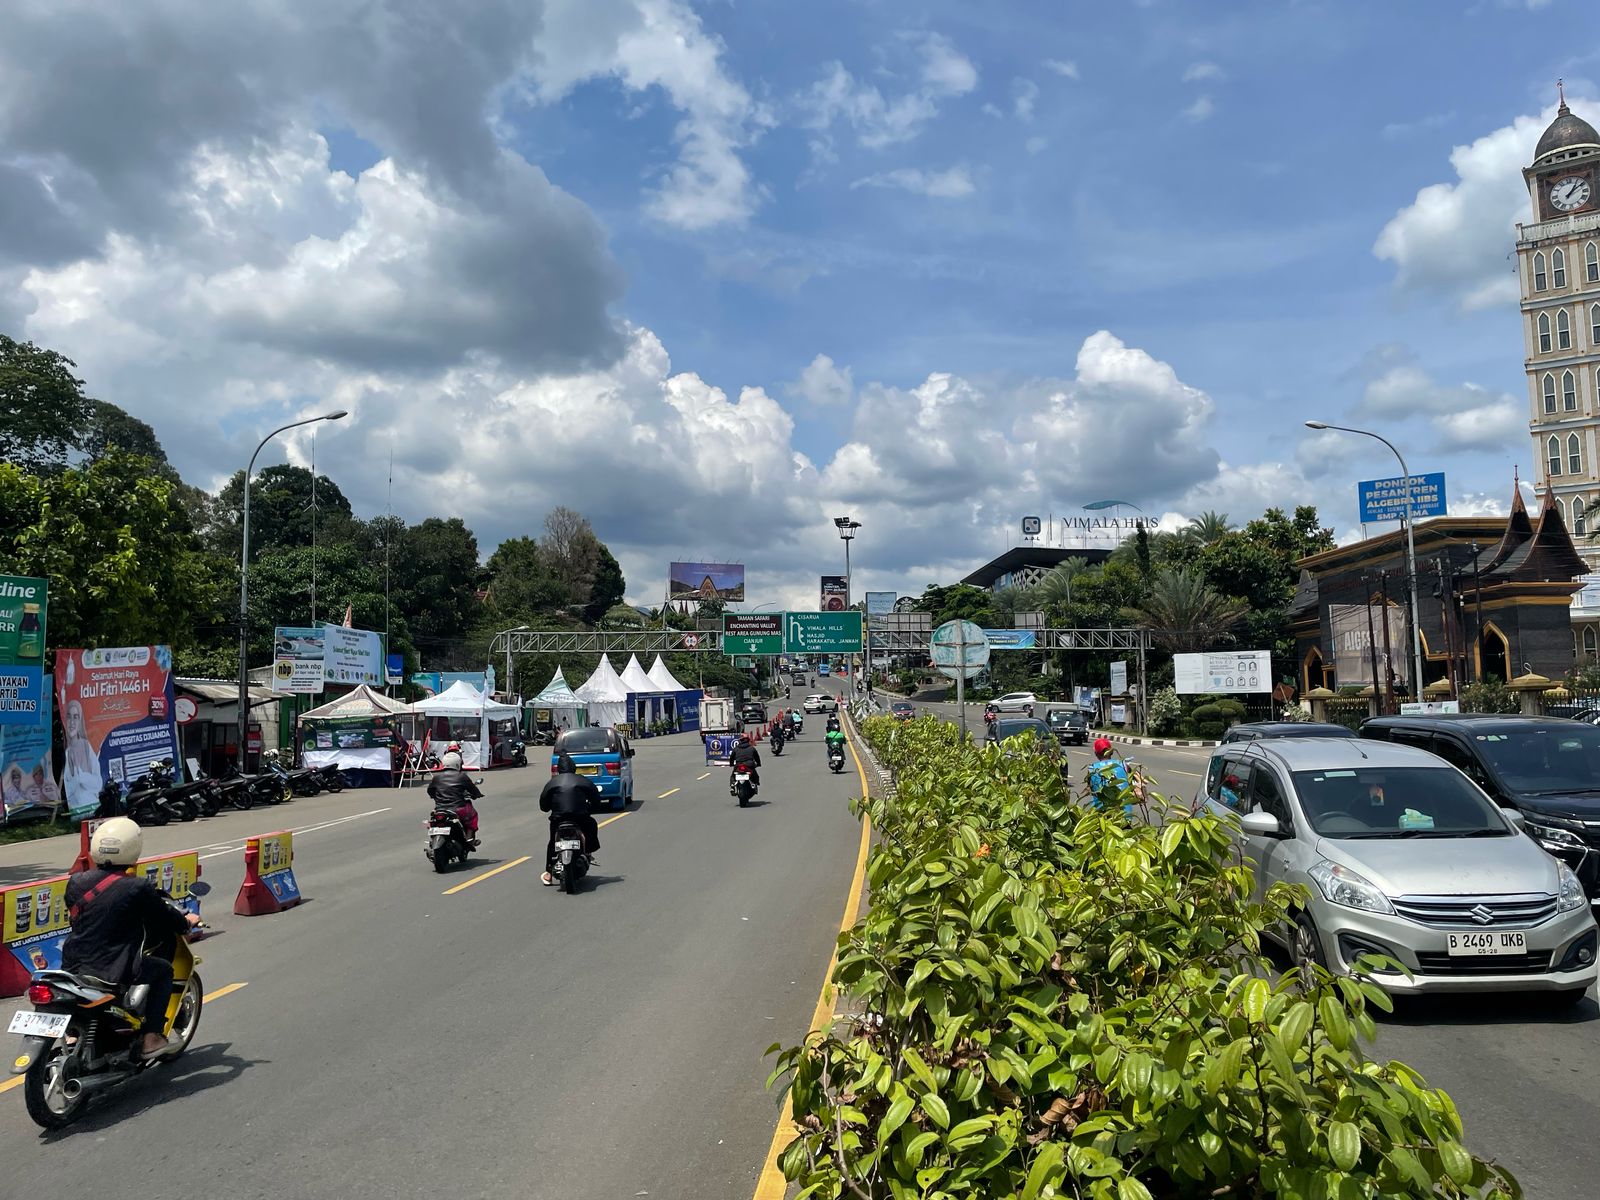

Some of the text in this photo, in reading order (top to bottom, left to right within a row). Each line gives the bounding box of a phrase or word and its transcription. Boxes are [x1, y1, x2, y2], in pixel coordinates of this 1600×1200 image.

[1375, 477, 1426, 489] PONDOK
[1367, 497, 1416, 508] ALGEBRA
[1064, 518, 1120, 532] VIMALA
[92, 670, 138, 680] Selamat Hari Raya
[278, 664, 291, 676] nbp
[81, 678, 150, 699] Idul Fitri 1446 H
[9, 700, 36, 710] LINTAS
[151, 701, 164, 709] 30%
[109, 735, 142, 747] UNIVERSITAS
[144, 730, 170, 741] DJUANDA
[38, 892, 50, 901] ABC
[18, 902, 30, 910] ABC
[22, 936, 40, 945] LANTAS
[1450, 934, 1524, 948] B 2469 UKB
[25, 1015, 47, 1024] 3777
